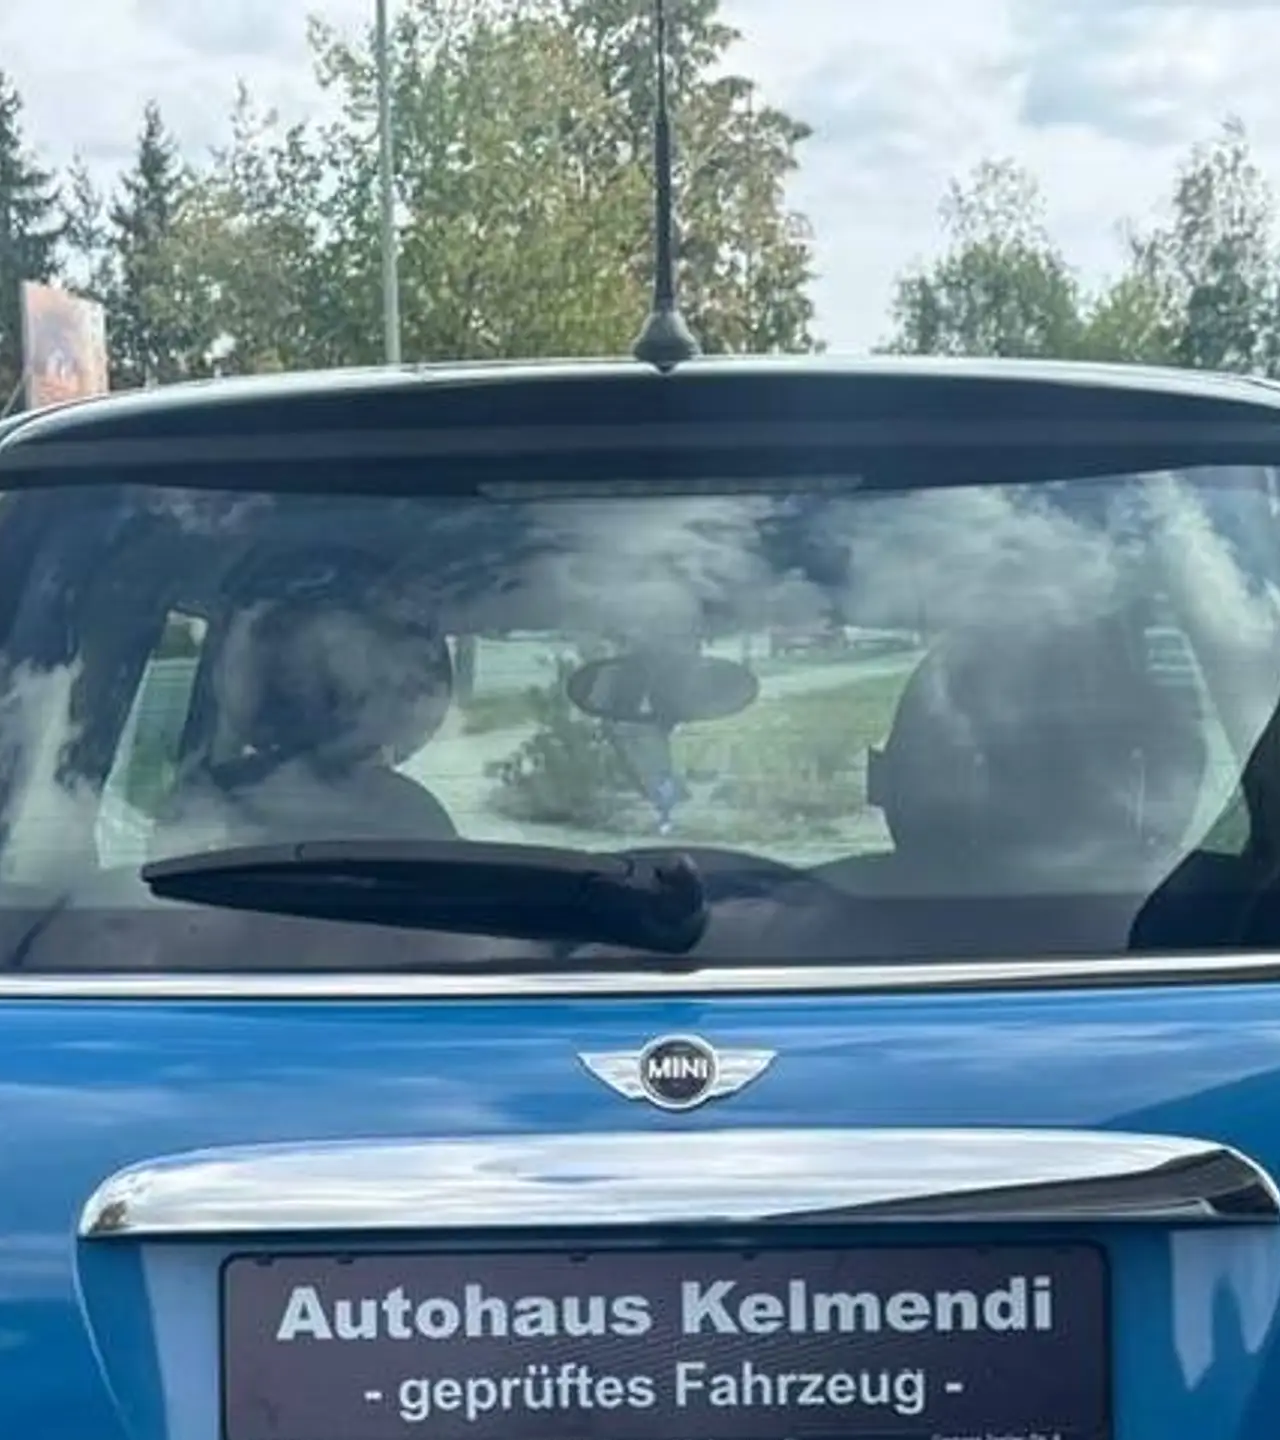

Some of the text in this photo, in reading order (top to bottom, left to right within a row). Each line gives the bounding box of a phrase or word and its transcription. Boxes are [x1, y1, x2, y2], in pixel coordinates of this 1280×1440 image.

[647, 1055, 708, 1080] MINI
[276, 1276, 1052, 1341] Autohaus Kelmendi
[398, 1363, 657, 1421] geprüftes
[675, 1361, 926, 1415] Fahrzeug
